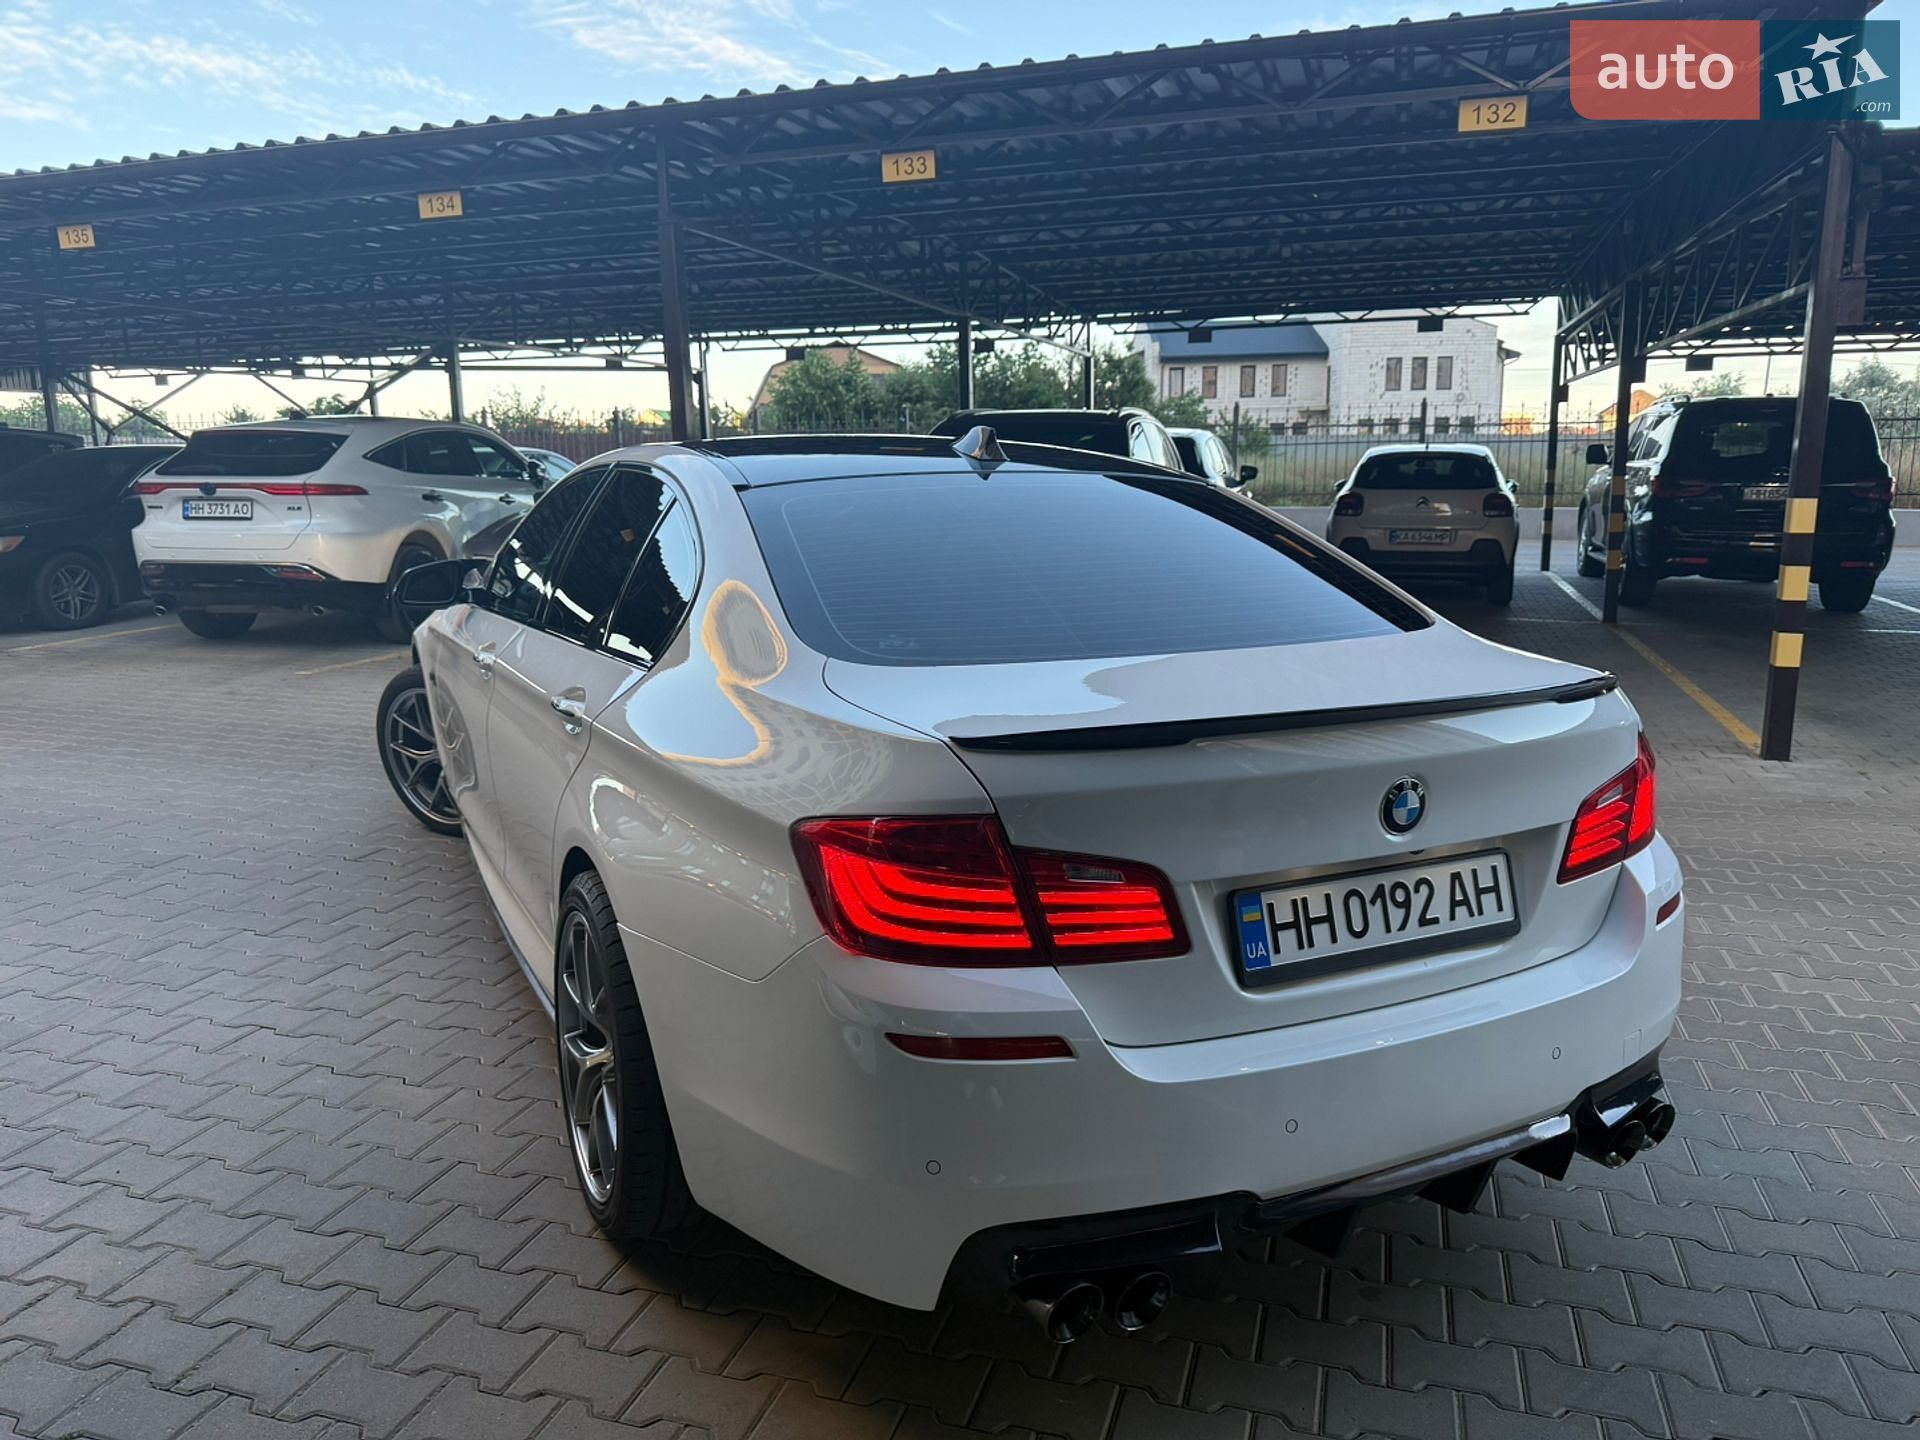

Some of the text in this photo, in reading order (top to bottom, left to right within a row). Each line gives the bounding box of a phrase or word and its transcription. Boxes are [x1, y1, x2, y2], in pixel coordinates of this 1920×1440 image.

[1472, 102, 1517, 125] 132
[891, 156, 928, 176] 133
[427, 196, 456, 214] 134
[65, 229, 89, 244] 135
[190, 502, 249, 515] HH 3731 AO
[1388, 780, 1424, 799] BMW
[1266, 864, 1504, 955] HH 0192 AH
[1245, 942, 1267, 960] UA
